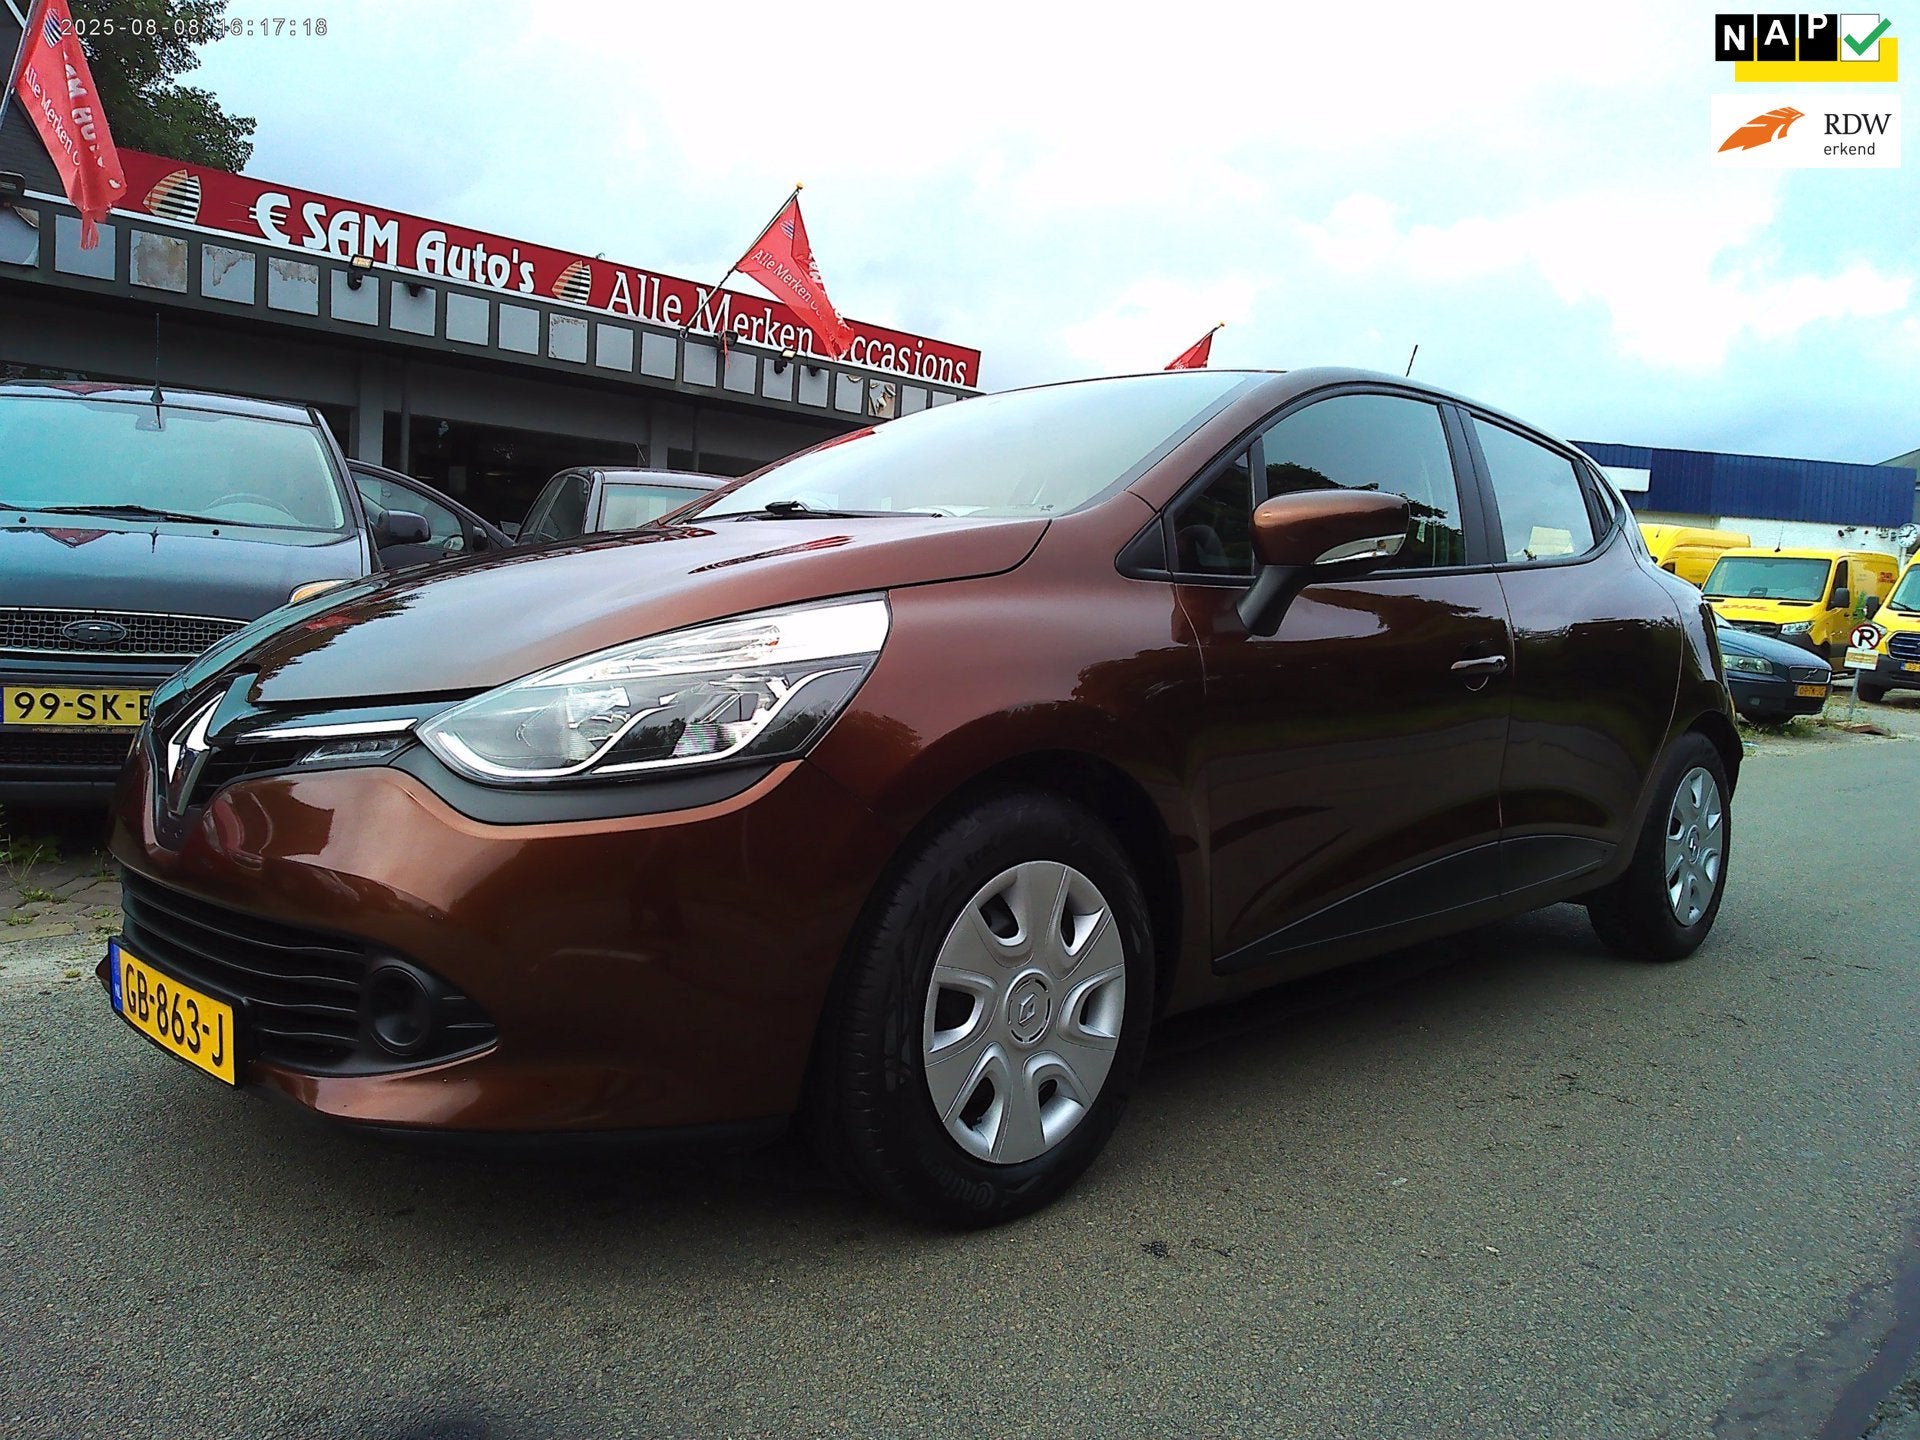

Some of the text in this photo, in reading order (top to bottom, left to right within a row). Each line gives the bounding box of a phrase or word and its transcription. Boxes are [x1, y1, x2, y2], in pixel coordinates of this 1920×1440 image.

[24, 62, 73, 150] Alle Merken
[302, 202, 399, 266] SAM
[416, 230, 535, 294] Auto's
[751, 250, 775, 270] Alle
[773, 264, 811, 303] Merken
[607, 270, 682, 326] Alle
[691, 287, 814, 356] Merken
[837, 335, 967, 386] ccasions
[126, 963, 223, 1067] GB-863-J
